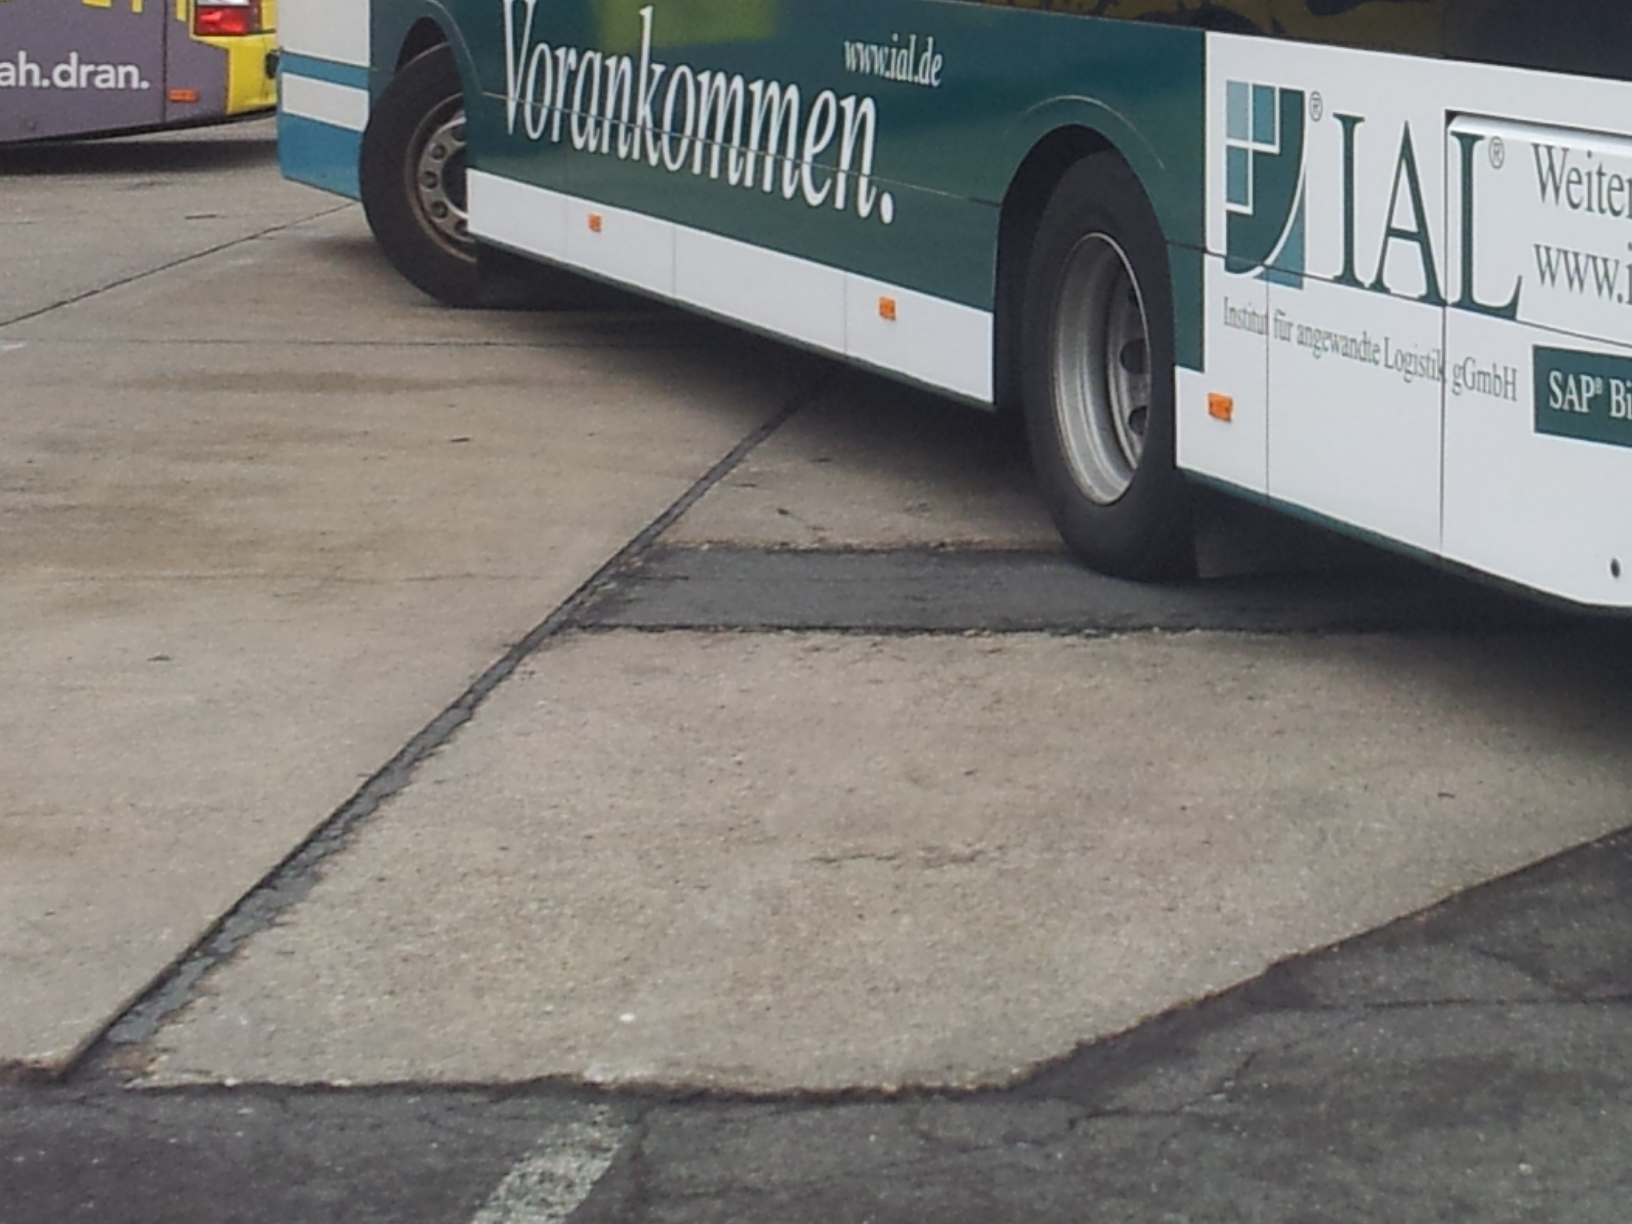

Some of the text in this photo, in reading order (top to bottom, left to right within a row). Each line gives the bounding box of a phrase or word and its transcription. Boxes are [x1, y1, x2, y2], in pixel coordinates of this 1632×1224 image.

[843, 32, 945, 88] www.ial.de
[1273, 308, 1295, 343] für
[1296, 322, 1382, 368] angewandte
[1451, 355, 1519, 403] gGmbH
